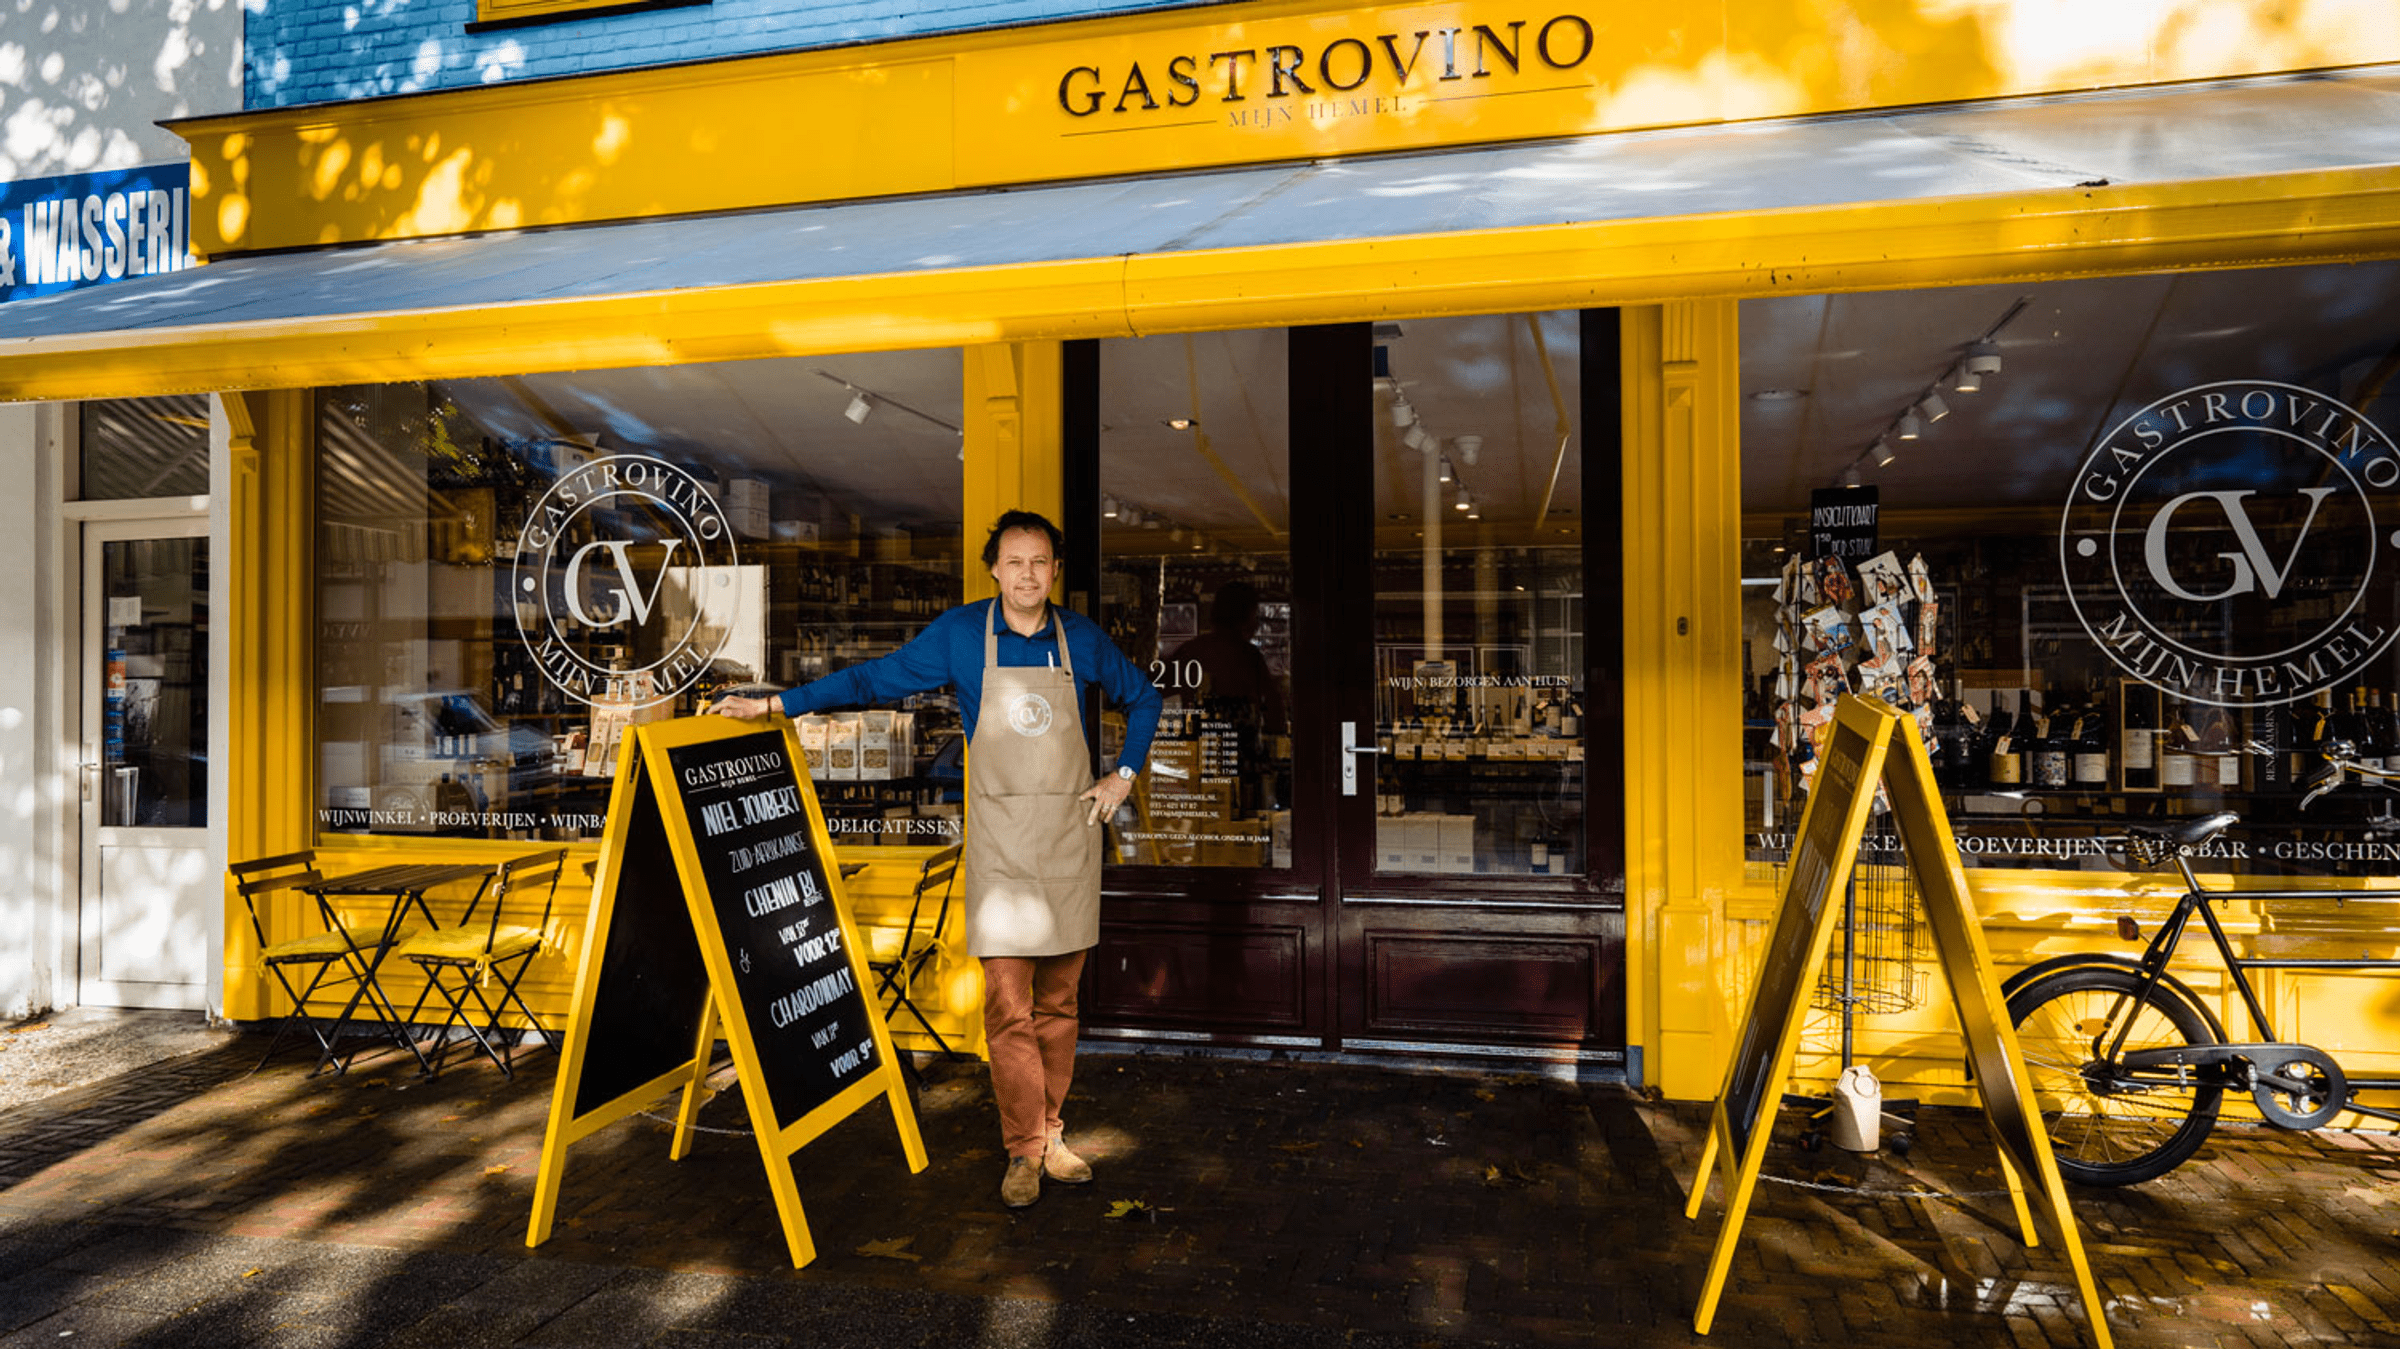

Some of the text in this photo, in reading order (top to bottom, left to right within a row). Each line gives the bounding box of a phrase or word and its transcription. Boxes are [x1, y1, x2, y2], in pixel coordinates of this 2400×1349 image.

[1059, 14, 1594, 117] GASTROVINO
[1229, 96, 1407, 129] MIJN HEMEL
[24, 187, 196, 284] WASSERI
[2084, 389, 2399, 501] GASTROVINO
[527, 462, 722, 549] GASTROVINO
[2144, 486, 2337, 602] GV
[563, 538, 683, 628] GV
[534, 635, 710, 702] MIJN HEMEL
[1150, 658, 1203, 689] 210
[1429, 675, 1501, 688] BEZORGEN
[1503, 675, 1532, 687] AAN
[1535, 674, 1569, 687] HUIS
[2098, 609, 2385, 698] MIJN HEMEL
[684, 751, 782, 787] GASTROVINO
[319, 808, 416, 827] WIJNWINKEL
[429, 811, 536, 830] PROEVERIJEN
[827, 817, 961, 835] DELICATESSEN
[700, 785, 800, 837] NIEL JOUBERT
[744, 875, 800, 918] CHENIN
[793, 935, 828, 968] VOOR
[770, 965, 854, 1029] CHARDONNAY
[829, 1047, 861, 1078] VOOR
